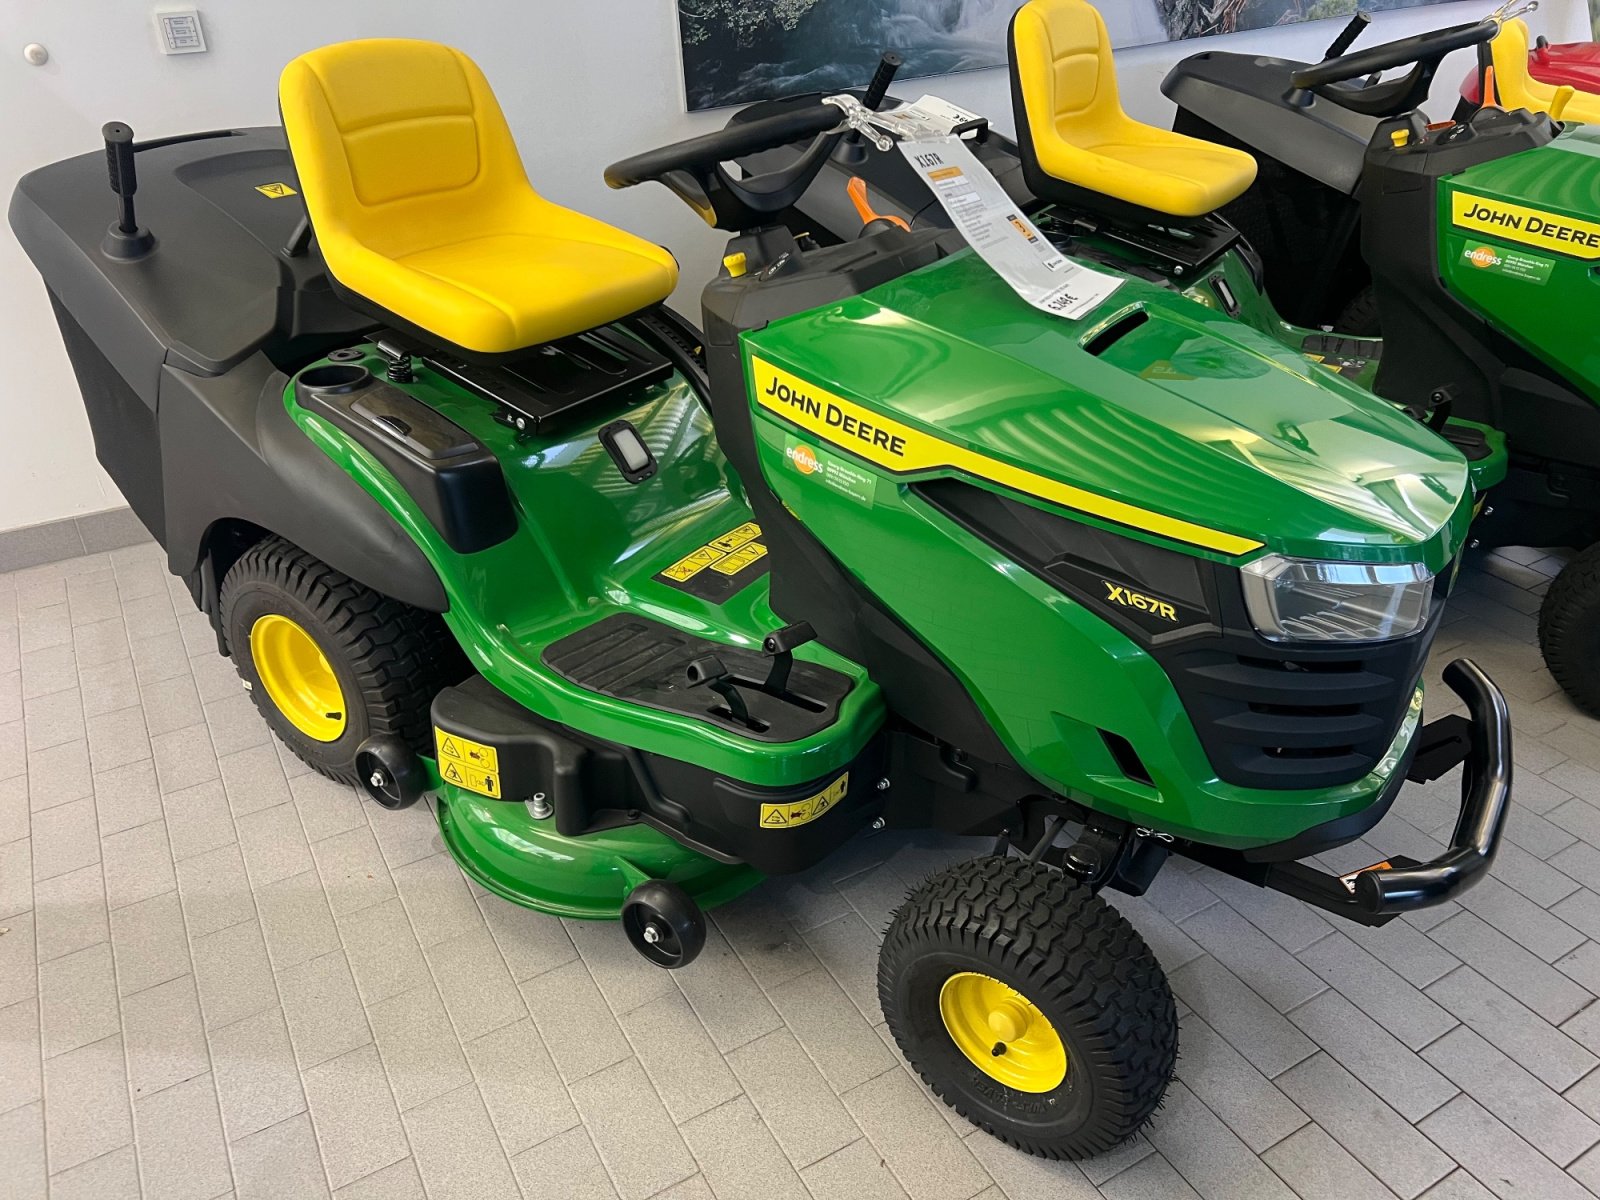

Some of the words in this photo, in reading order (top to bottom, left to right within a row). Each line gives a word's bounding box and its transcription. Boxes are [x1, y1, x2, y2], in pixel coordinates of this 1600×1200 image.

[914, 152, 944, 168] X167R
[1464, 203, 1522, 230] JOHN
[1525, 217, 1600, 248] DEERE
[1464, 249, 1502, 266] endress
[766, 377, 820, 419] JOHN
[825, 405, 906, 456] DEERE
[786, 448, 823, 474] endress
[1105, 582, 1177, 622] X167R
